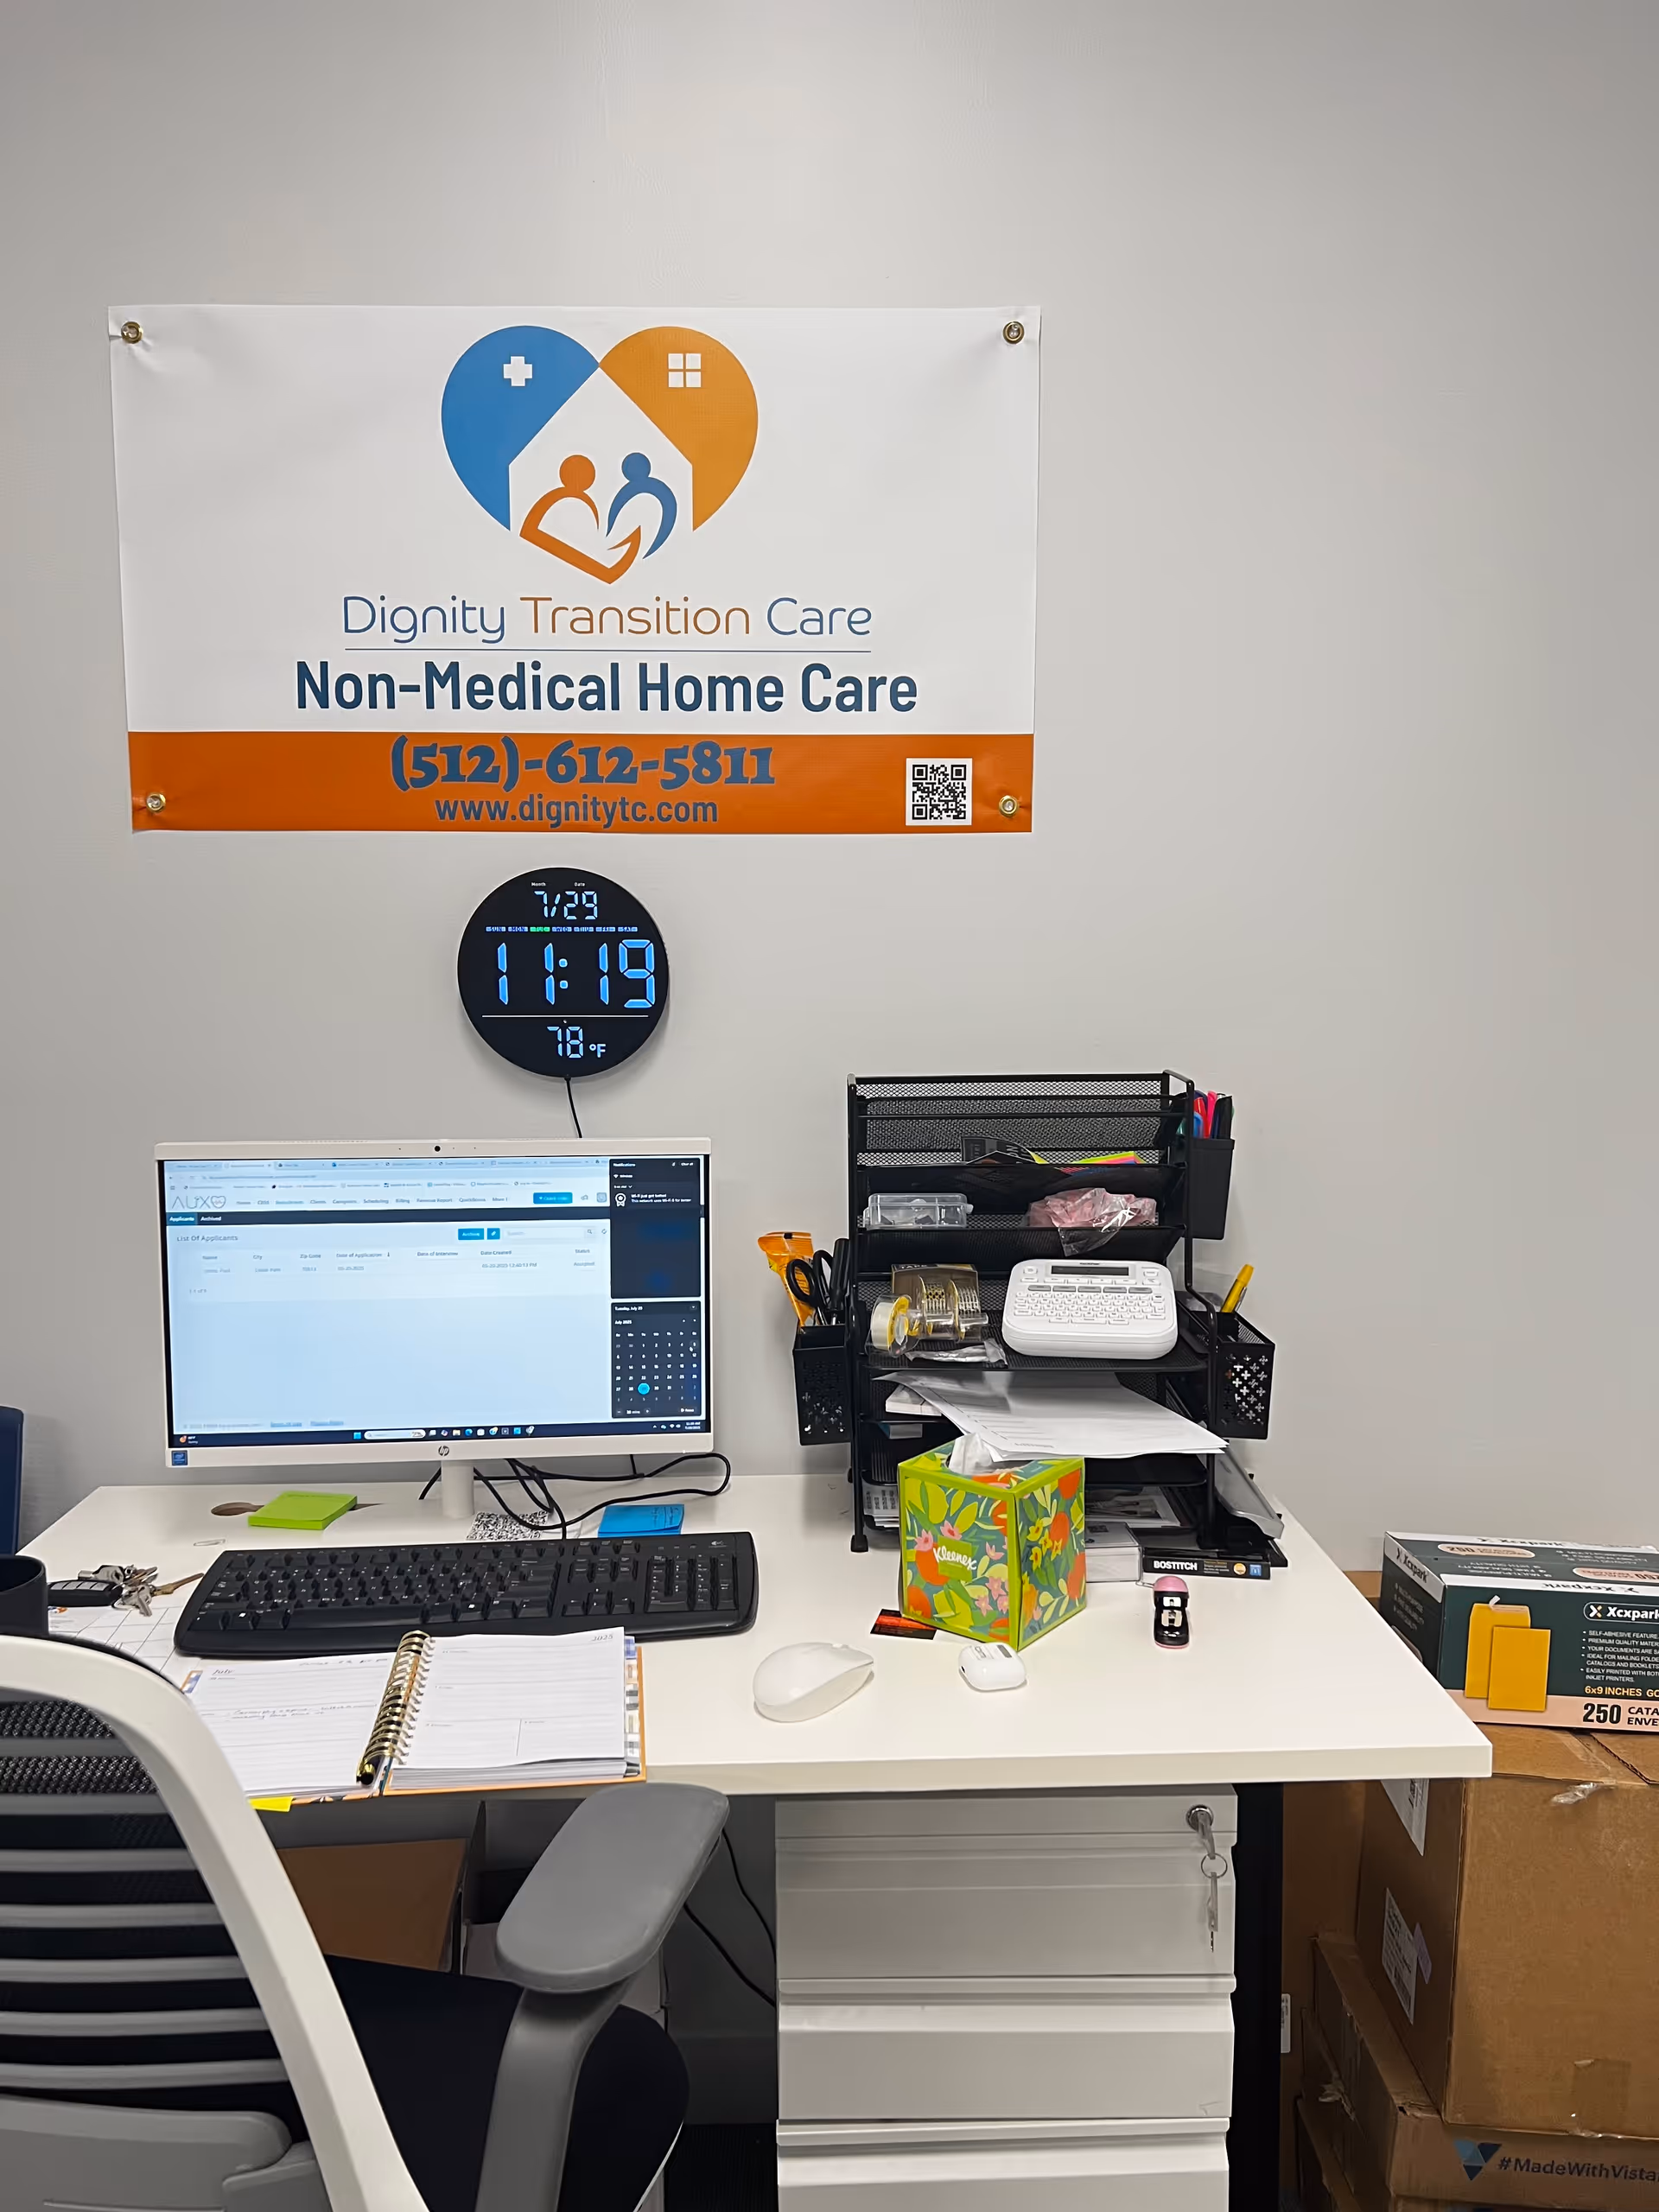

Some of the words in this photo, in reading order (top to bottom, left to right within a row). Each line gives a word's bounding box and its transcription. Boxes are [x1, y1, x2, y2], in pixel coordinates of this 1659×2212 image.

[343, 594, 505, 644] Dignity
[519, 595, 750, 636] Transition
[766, 597, 873, 636] Care
[296, 660, 620, 711] Non-Medical
[639, 662, 785, 712] Home
[801, 663, 918, 713] Care
[391, 734, 776, 793] (512)-612-5811
[435, 793, 719, 830] www.dignitytc.com
[534, 891, 598, 920] 7/29
[497, 938, 656, 1008] 11:19
[547, 1026, 583, 1058] 78
[438, 1445, 450, 1457] hp
[932, 1545, 977, 1571] Kleenex
[1153, 1560, 1198, 1571] BOSTITCH
[1541, 1582, 1616, 1593] Xcxpark
[1585, 1685, 1604, 1694] 6x9
[1605, 1686, 1643, 1697] INCHES
[1582, 1702, 1622, 1725] 250
[1497, 2156, 1659, 2183] #MadeWithVista
